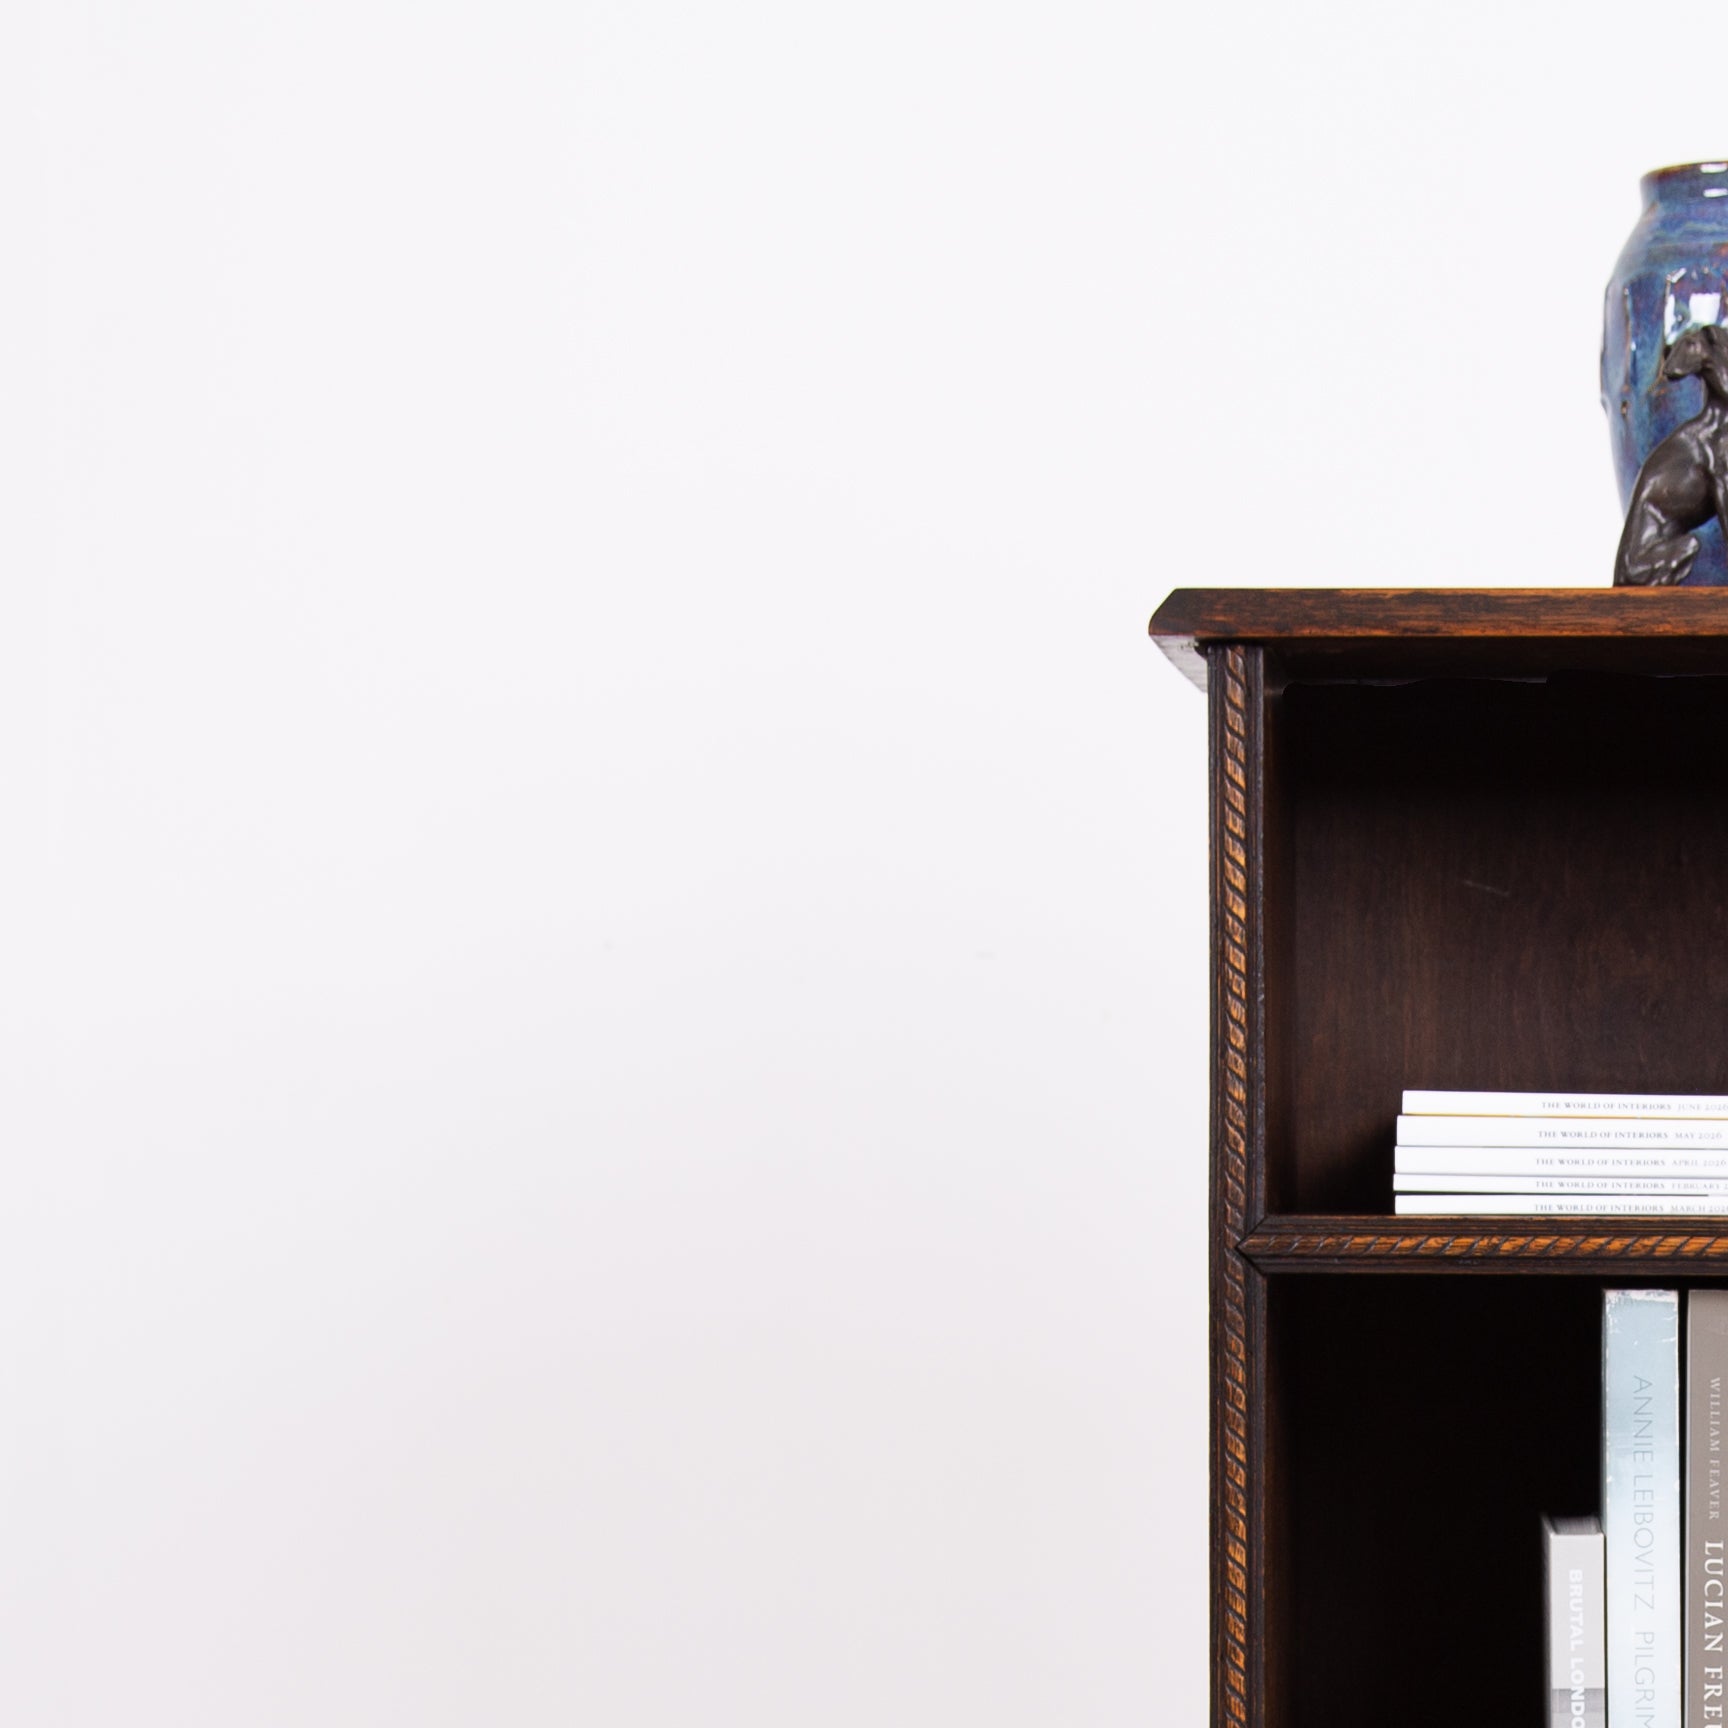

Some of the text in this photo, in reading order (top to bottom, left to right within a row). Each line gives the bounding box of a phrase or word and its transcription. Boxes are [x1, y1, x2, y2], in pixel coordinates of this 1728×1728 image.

[1541, 1101, 1560, 1109] THE
[1564, 1101, 1601, 1109] WORLD
[1603, 1102, 1615, 1110] OF
[1617, 1102, 1672, 1110] INTERIORS
[1677, 1103, 1701, 1111] JUNE
[1561, 1131, 1597, 1139] WORLD
[1599, 1131, 1611, 1139] OF
[1614, 1131, 1669, 1139] INTERIORS
[1558, 1158, 1595, 1166] WORLD
[1597, 1158, 1609, 1166] OF
[1611, 1158, 1666, 1166] INTERIORS
[1671, 1159, 1698, 1167] APRIL
[1596, 1181, 1608, 1189] OF
[1671, 1182, 1721, 1190] FEBRUARY
[1556, 1204, 1594, 1212] WORLD
[1595, 1204, 1608, 1212] OF
[1610, 1204, 1664, 1212] INTERIORS
[1670, 1205, 1707, 1213] MARCH
[1633, 1375, 1654, 1462] ANNIE
[1709, 1377, 1721, 1452] WILLIAM
[1708, 1460, 1720, 1521] FEAVER
[1633, 1474, 1655, 1611] LEIBOVITZ
[1569, 1569, 1583, 1652] BRUTAL
[1704, 1541, 1724, 1653] LUCIAN
